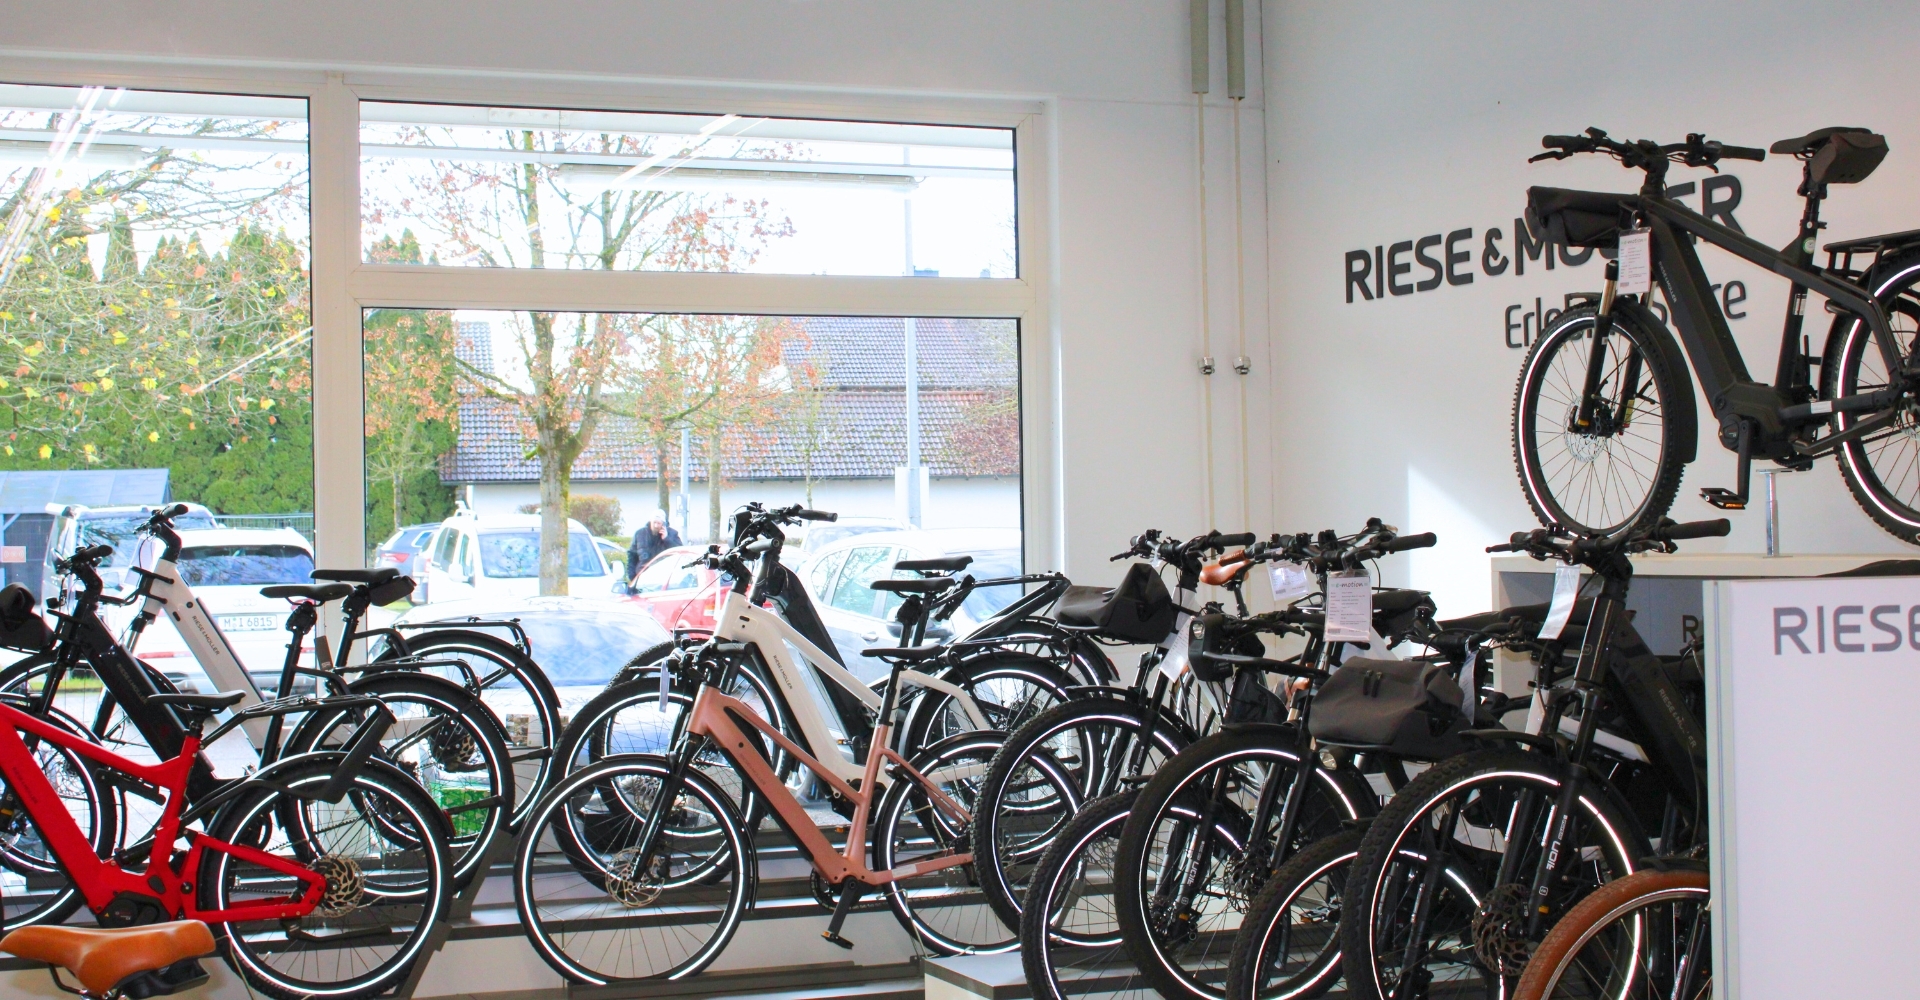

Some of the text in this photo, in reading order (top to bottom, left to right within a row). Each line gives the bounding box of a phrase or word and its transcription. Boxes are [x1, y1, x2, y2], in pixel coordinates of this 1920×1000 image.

[1345, 227, 1473, 304] RIESE
[1481, 227, 1509, 276] &
[247, 616, 273, 627] 6815
